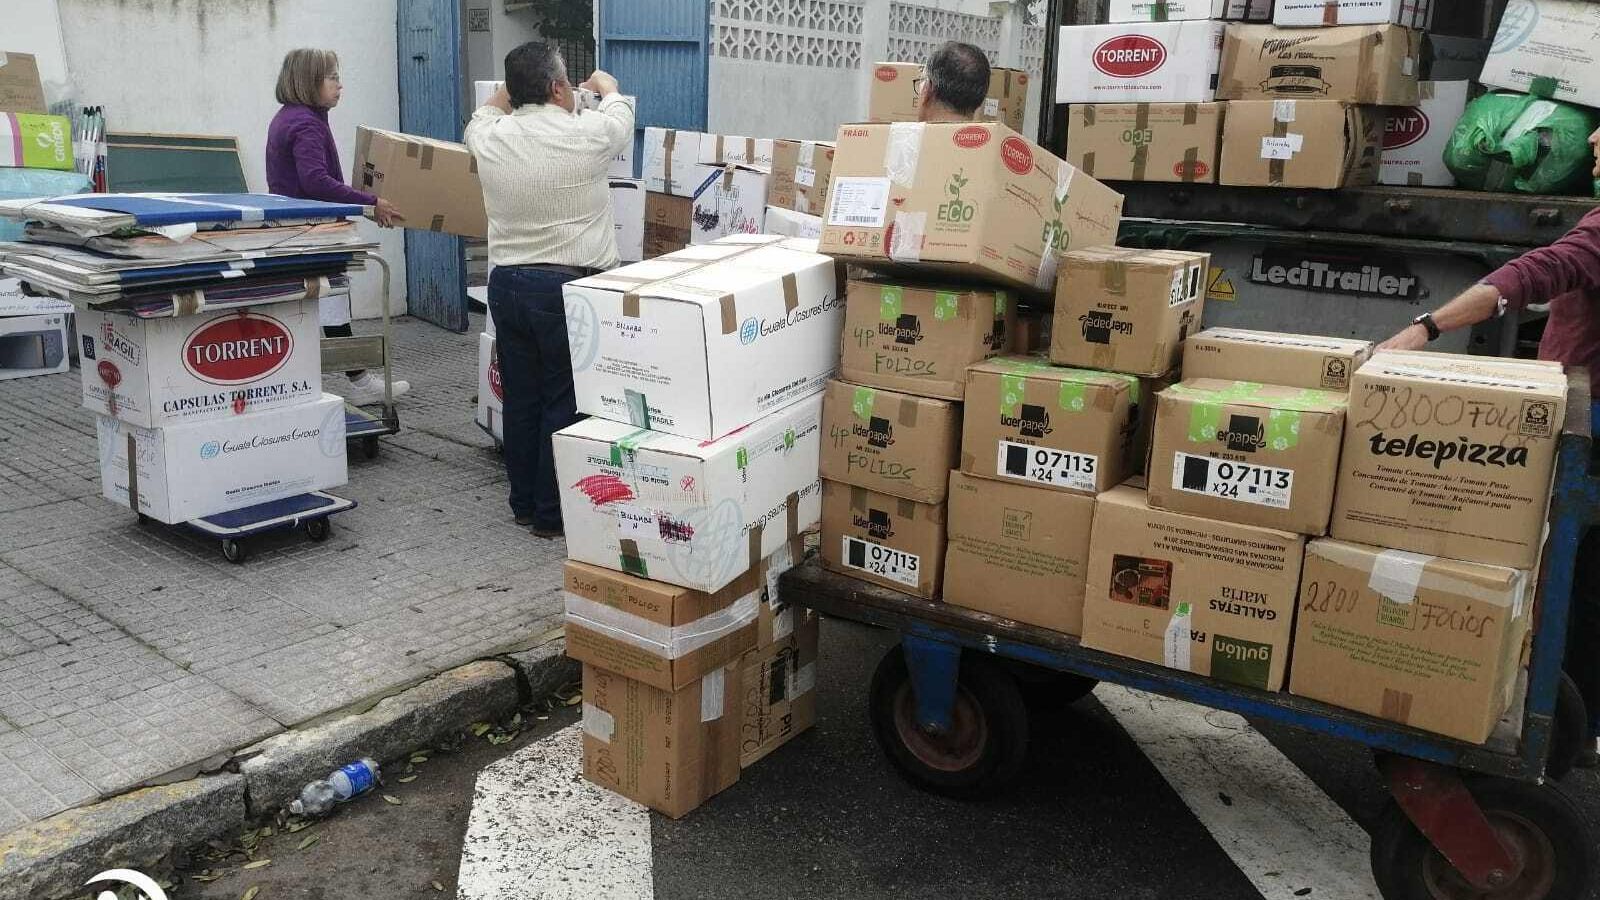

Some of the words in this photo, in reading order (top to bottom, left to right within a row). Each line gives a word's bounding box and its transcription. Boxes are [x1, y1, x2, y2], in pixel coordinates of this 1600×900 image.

[1099, 48, 1159, 64] TORRENT
[956, 132, 987, 143] TORRENT
[1122, 130, 1153, 145] ECO
[1004, 144, 1030, 166] TORRENT
[937, 203, 975, 222] ECO
[1042, 220, 1070, 250] ECO
[1252, 257, 1416, 296] LeciTrailer
[760, 317, 786, 337] Guala
[786, 303, 822, 326] Closures
[878, 315, 924, 342] liderpapel
[192, 335, 285, 365] TORRENT
[875, 353, 937, 375] FOLIOS
[163, 392, 226, 414] CAPSULAS
[291, 381, 312, 392] S.A.
[1356, 386, 1465, 431] 2800
[222, 439, 251, 454] Guala
[252, 433, 290, 451] Closures
[291, 427, 320, 441] Group
[852, 422, 895, 446] liderpapel
[1217, 420, 1267, 449] erpapel
[1035, 450, 1095, 473] 07113
[1369, 431, 1529, 469] telepizza
[848, 452, 916, 479] FOLIOS
[1031, 467, 1053, 482] x24
[1217, 462, 1290, 489] 07113
[1213, 482, 1239, 498] x24
[1247, 540, 1286, 552] ALIMENTOS
[1250, 551, 1285, 563] PERSONAS
[869, 561, 886, 576] x24
[872, 546, 918, 571] 07113
[1213, 553, 1234, 564] AYUDA
[1245, 559, 1284, 571] PROGRAMA
[1221, 586, 1268, 605] María
[1304, 581, 1359, 613] 2800
[1209, 599, 1277, 621] GALLETAS
[1215, 639, 1270, 662] gullón
